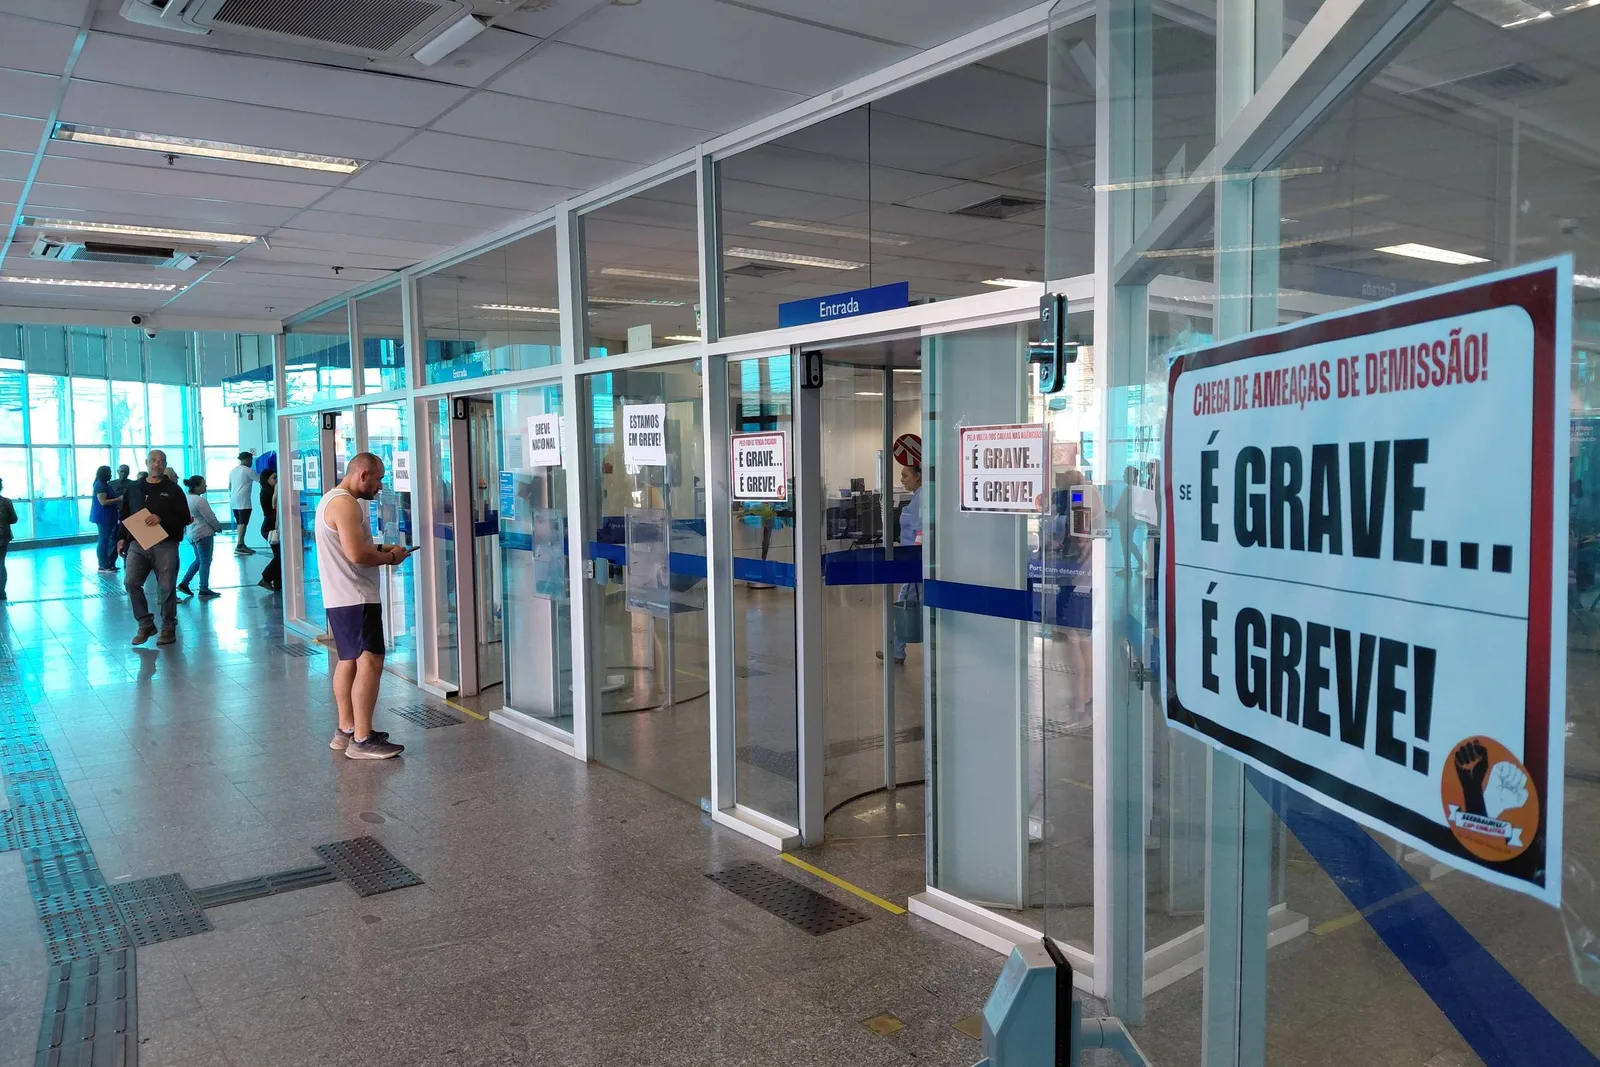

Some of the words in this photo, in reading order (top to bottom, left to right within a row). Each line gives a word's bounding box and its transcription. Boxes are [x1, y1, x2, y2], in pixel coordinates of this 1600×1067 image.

[820, 297, 859, 318] Entrada
[1193, 377, 1230, 416] CHEGA
[1233, 374, 1248, 411] DE
[1252, 360, 1331, 411] AMEAÇAS
[1337, 355, 1360, 399] DE
[1365, 327, 1488, 396] DEMISSÃO!
[535, 422, 551, 436] GREVE
[629, 414, 659, 429] ESTAMOS
[532, 437, 556, 451] NACIONAL
[628, 432, 638, 447] EM
[639, 432, 661, 447] GREVE!
[739, 448, 744, 467] É
[746, 450, 782, 467] GRAVE...
[972, 444, 979, 469] É
[983, 446, 1041, 469] GRAVE..
[740, 473, 744, 492] É
[746, 476, 776, 492] GREVE!
[972, 477, 979, 501] É
[983, 480, 1033, 503] GREVE!
[1179, 484, 1192, 500] SE
[1200, 429, 1220, 542] É
[1233, 437, 1513, 574] GRAVE...
[1029, 564, 1043, 572] Port
[1059, 568, 1085, 576] detector
[1201, 581, 1219, 695] É
[1234, 607, 1437, 777] GREVE!
